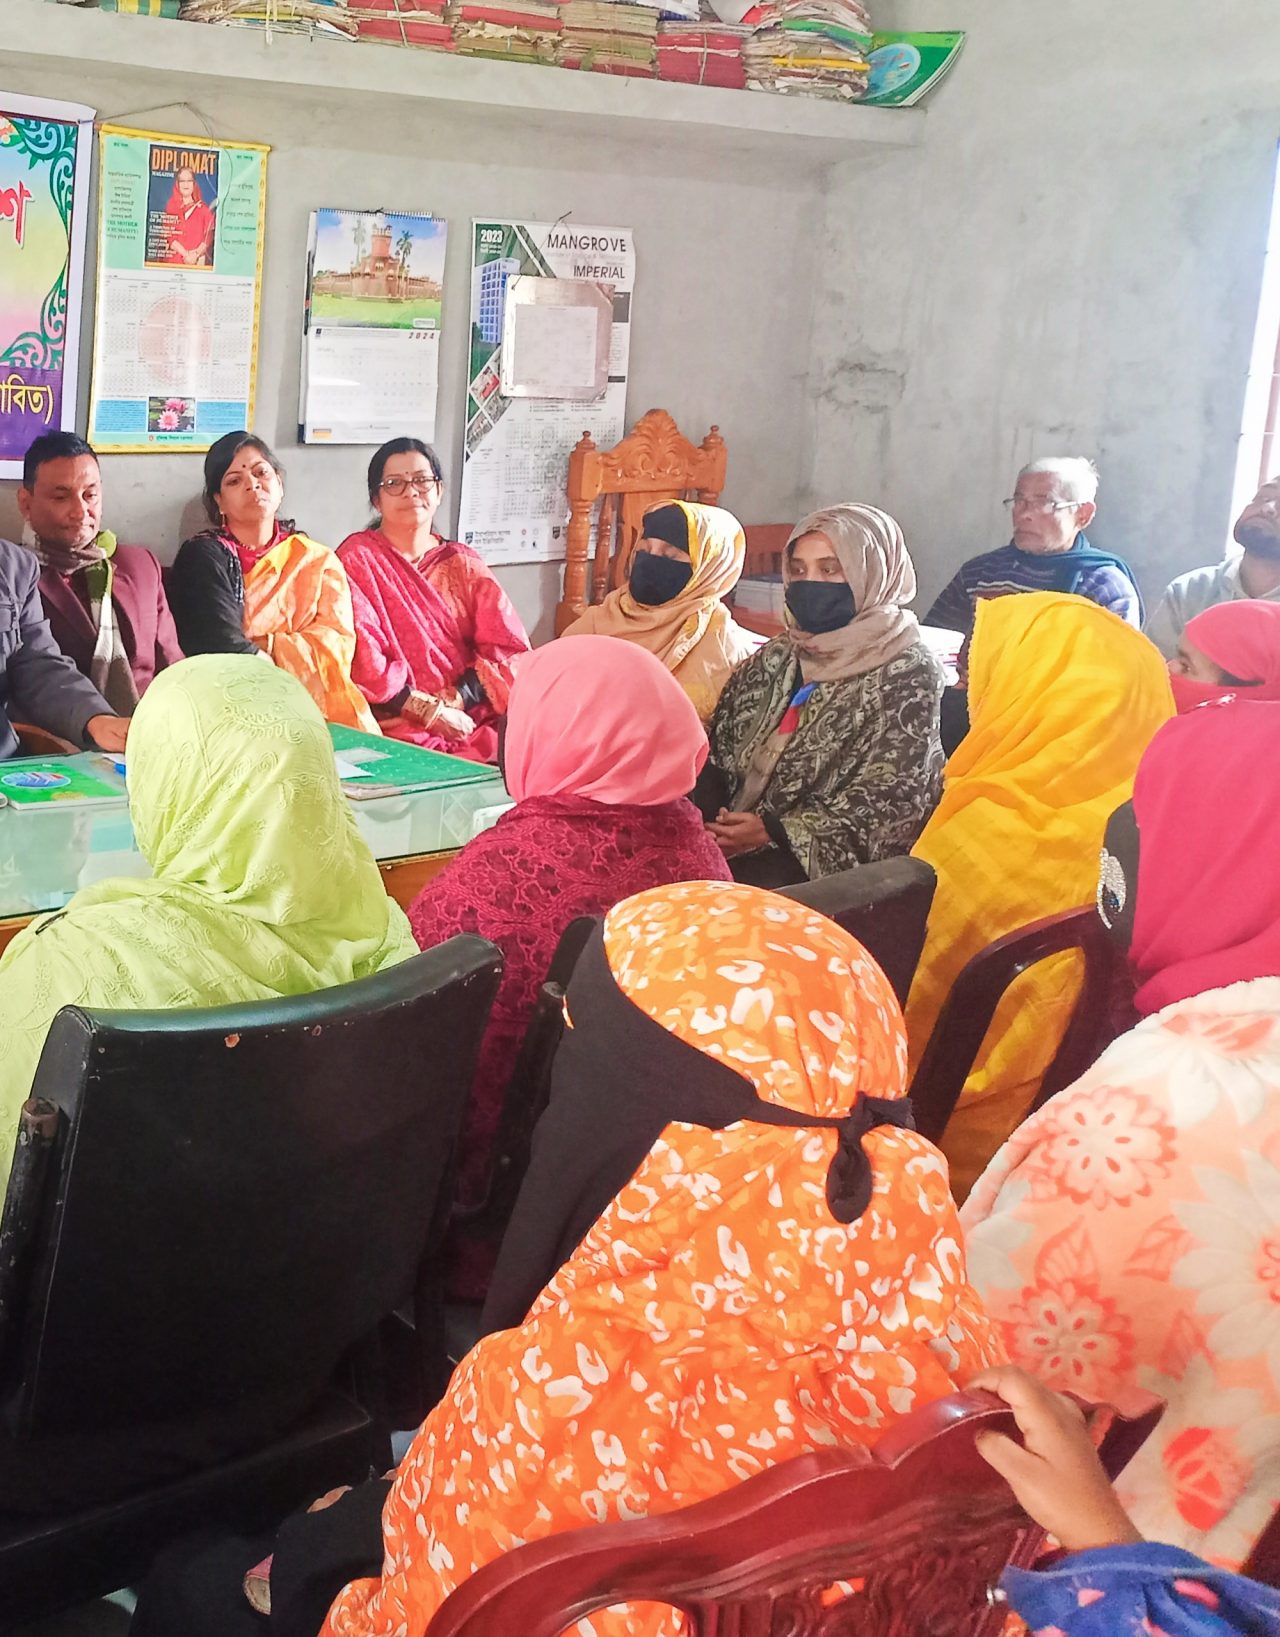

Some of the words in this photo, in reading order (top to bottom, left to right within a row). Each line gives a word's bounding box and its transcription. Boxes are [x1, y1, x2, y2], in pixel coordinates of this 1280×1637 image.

[151, 148, 217, 175] DIPLOMAT
[480, 229, 503, 243] 2023
[547, 233, 627, 252] MANGROVE
[573, 265, 626, 279] IMPERIAL
[408, 332, 435, 340] 2024
